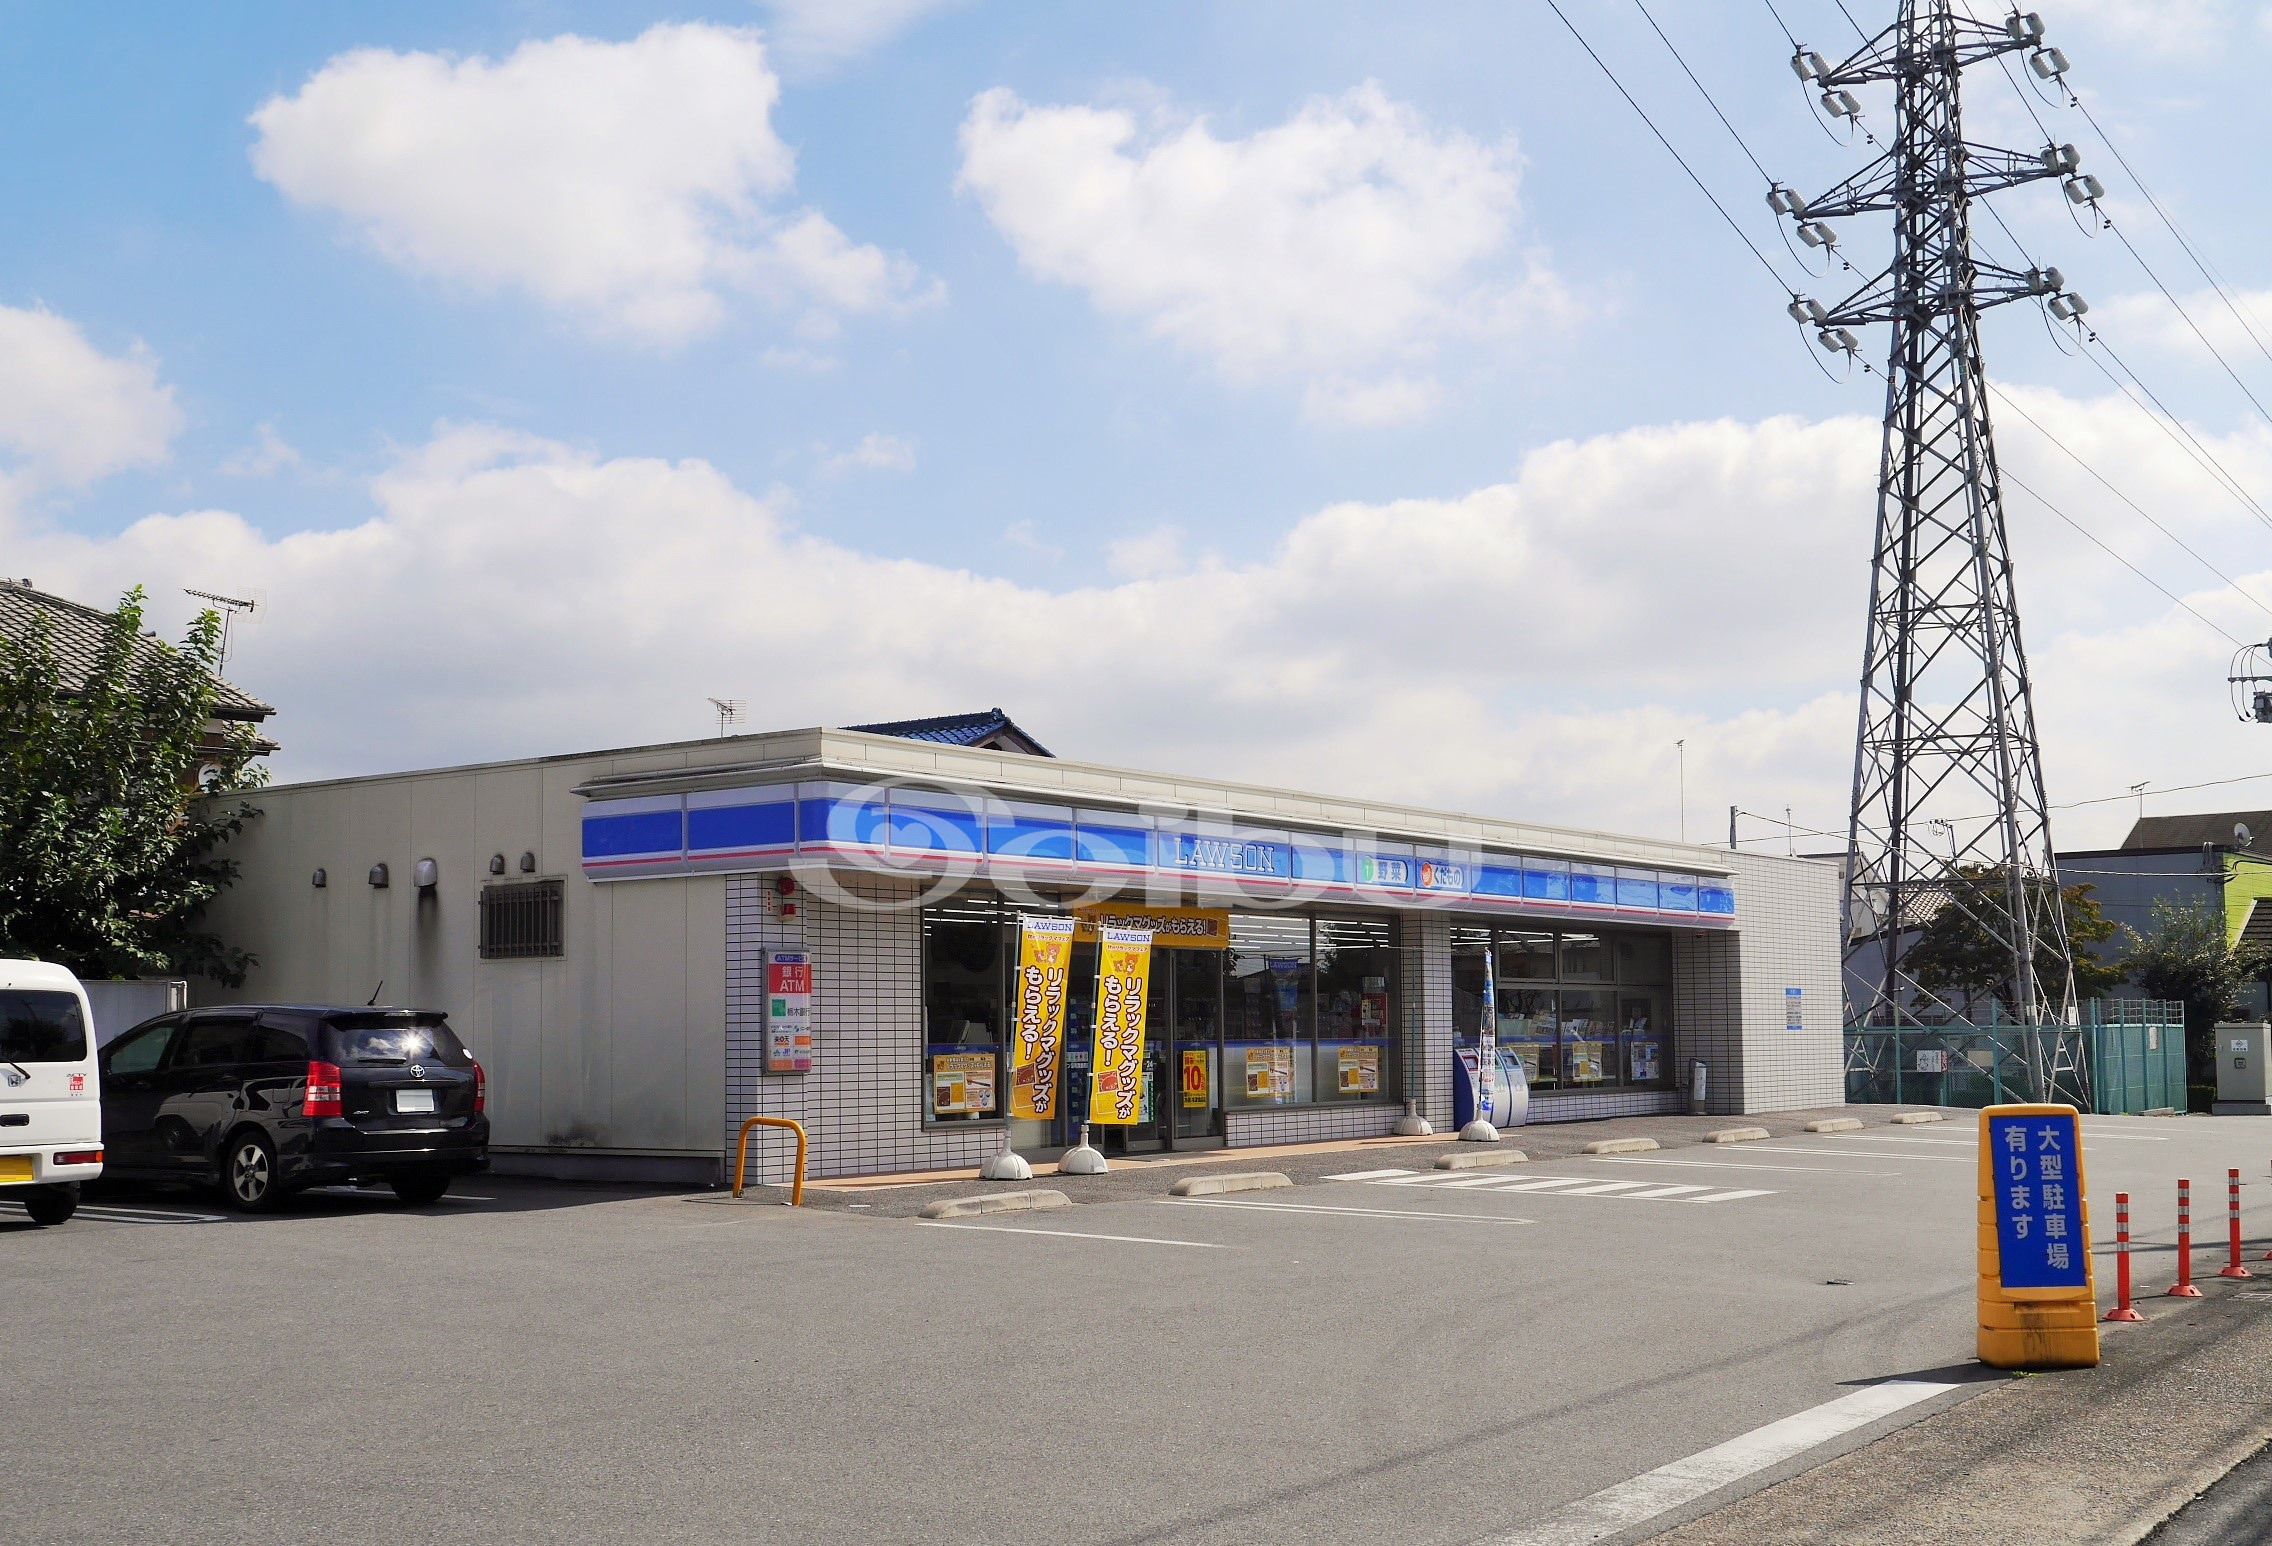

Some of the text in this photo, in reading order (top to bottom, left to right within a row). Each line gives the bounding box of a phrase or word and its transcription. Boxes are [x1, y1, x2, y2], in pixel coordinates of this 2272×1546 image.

[1174, 837, 1275, 873] LAWSON
[1378, 861, 1401, 880] 野菜
[1434, 866, 1461, 885] くだもの
[1027, 921, 1073, 932] LAWSON
[1107, 932, 1151, 942] LAWSON
[782, 965, 804, 978] 銀行
[780, 980, 805, 992] ATM
[787, 1007, 811, 1017] 栃木銀行
[1020, 965, 1044, 1060] もらえる!
[1100, 975, 1123, 1066] もらえる!
[1032, 967, 1064, 1113] リラックマグッズが
[1115, 977, 1143, 1119] リラックマグッズが
[1184, 1065, 1201, 1090] 10
[2004, 1125, 2034, 1240] 有ります
[2037, 1125, 2070, 1270] 大型駐車場
